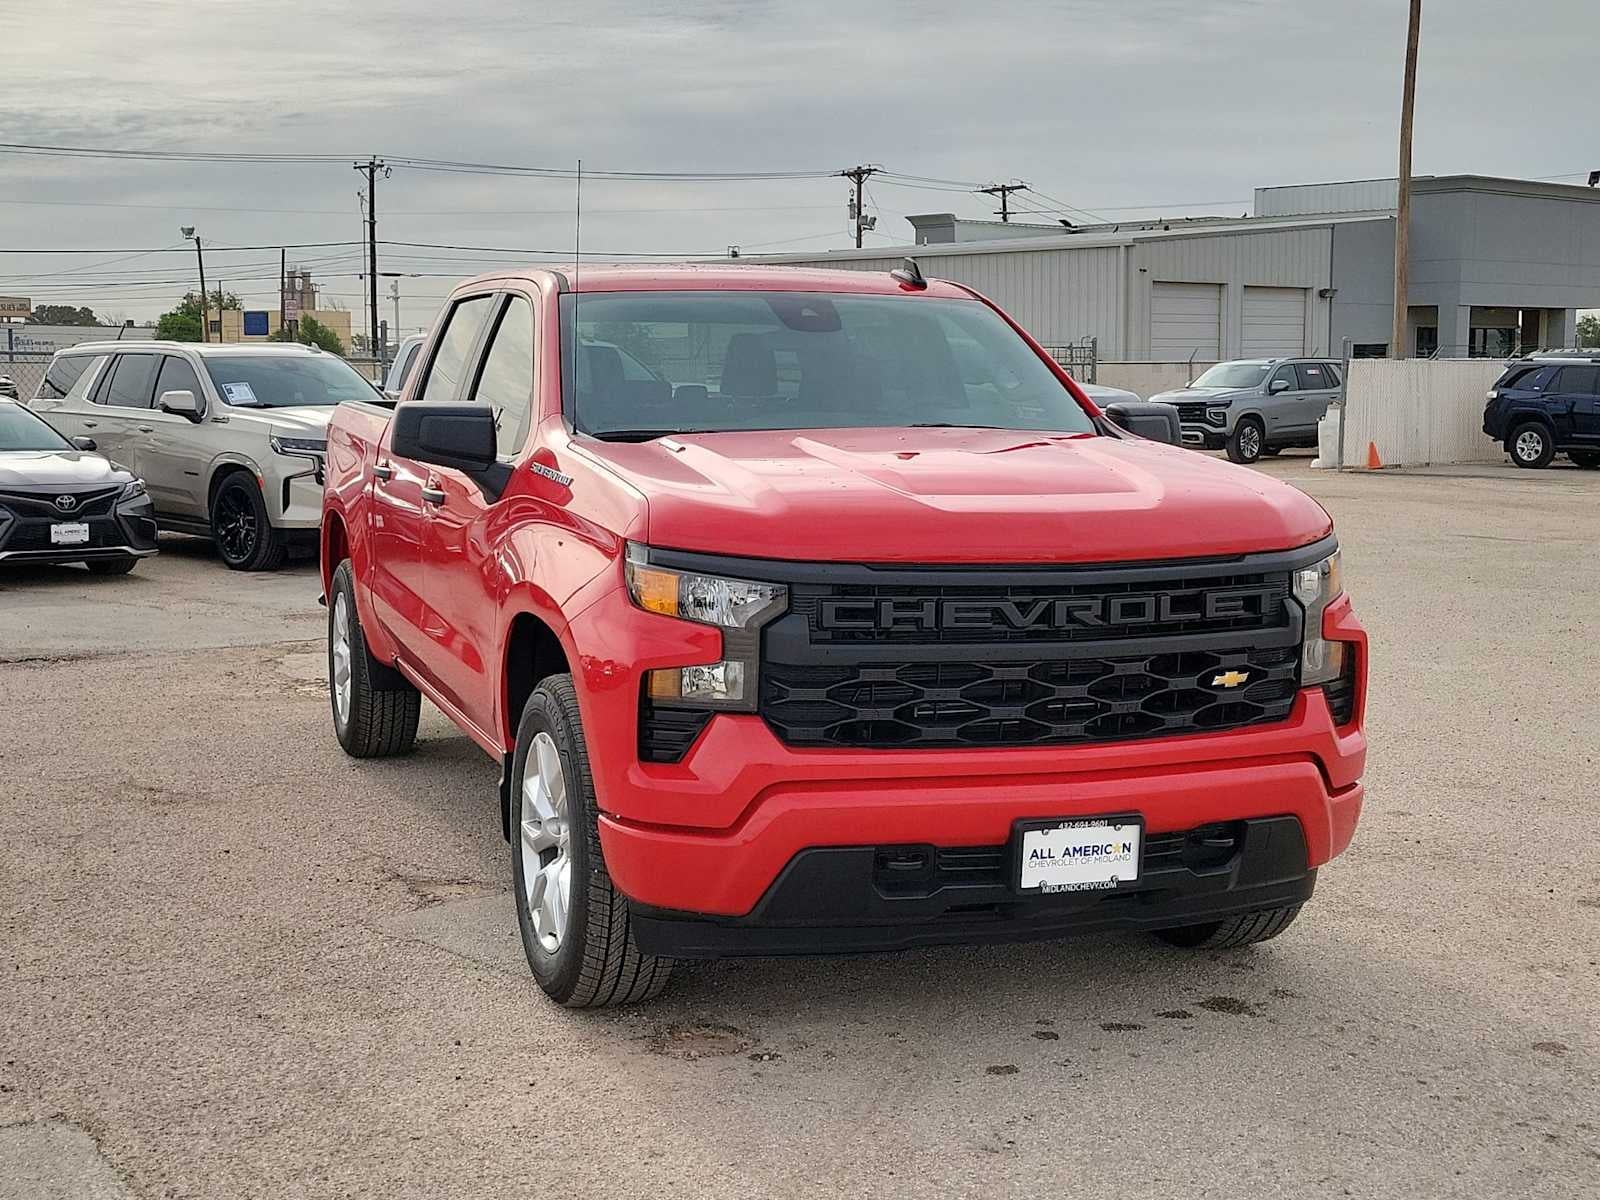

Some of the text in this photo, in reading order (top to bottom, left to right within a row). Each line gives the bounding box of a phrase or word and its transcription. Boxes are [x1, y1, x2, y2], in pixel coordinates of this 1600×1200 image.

[822, 588, 1284, 629] CHEVROLET
[1028, 853, 1131, 868] CHEVROLET OF MIDLAND
[1029, 848, 1055, 860] ALL
[1042, 881, 1117, 893] MIDLANDCHEVY.COM
